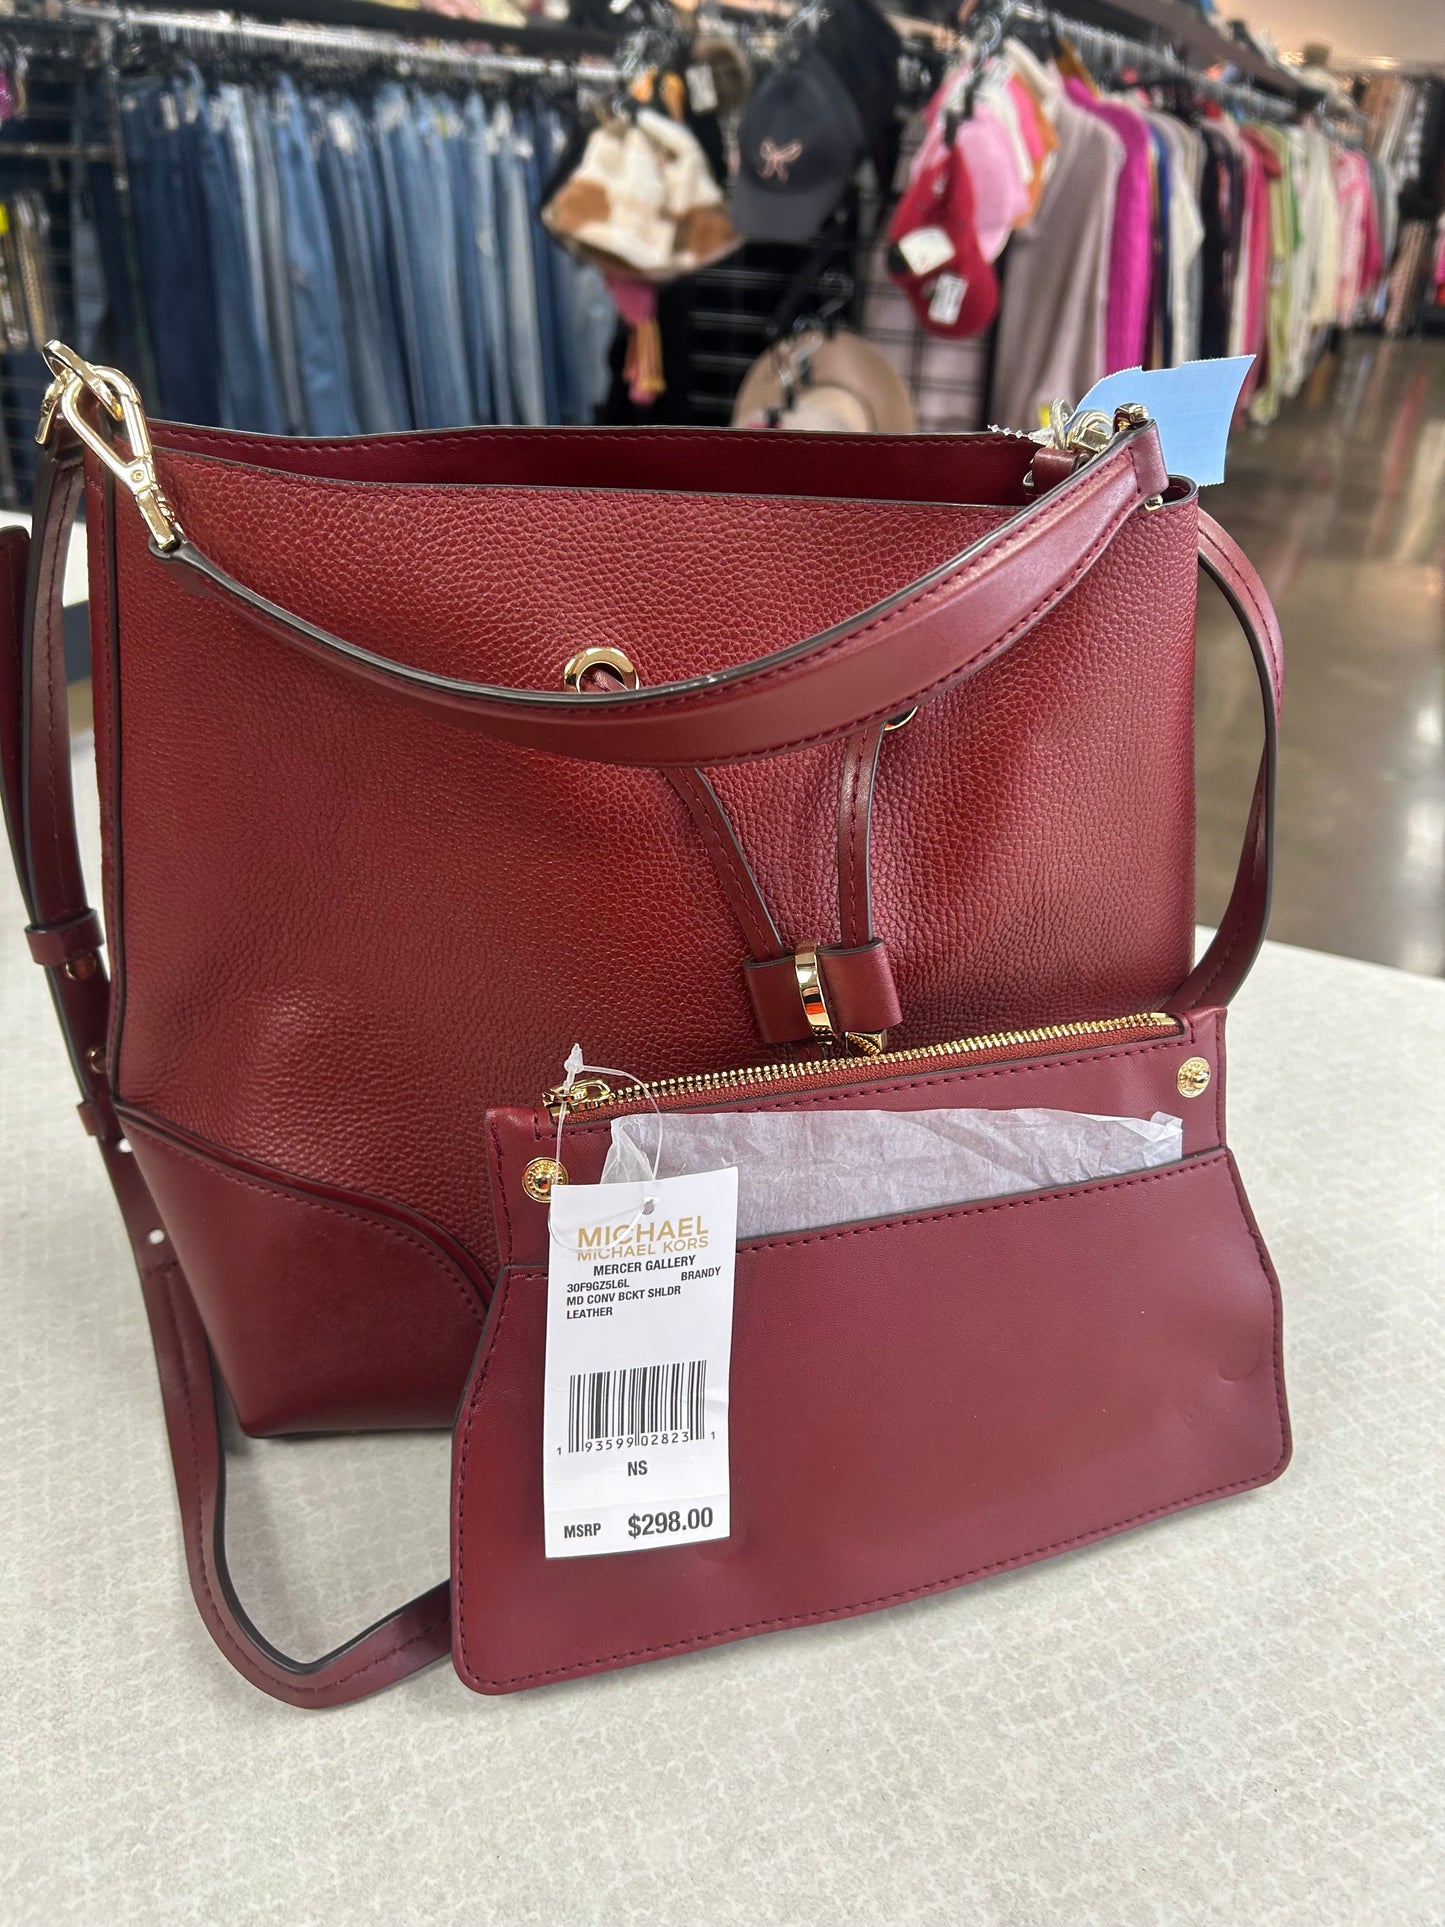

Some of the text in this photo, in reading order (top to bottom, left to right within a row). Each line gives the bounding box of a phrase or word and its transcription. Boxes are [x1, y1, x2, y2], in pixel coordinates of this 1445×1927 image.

[578, 1215, 709, 1248] MICHAEL
[577, 1236, 708, 1261] MICHAEL KORS
[593, 1255, 696, 1276] MERCER GALLERY
[567, 1266, 721, 1293] 30F9GZ5L6L BRANDY
[566, 1285, 681, 1306] MD CONV BCKT SHLDR
[567, 1306, 613, 1320] LEATHER
[627, 1460, 648, 1476] NS
[564, 1506, 713, 1539] MSRP $298.00
